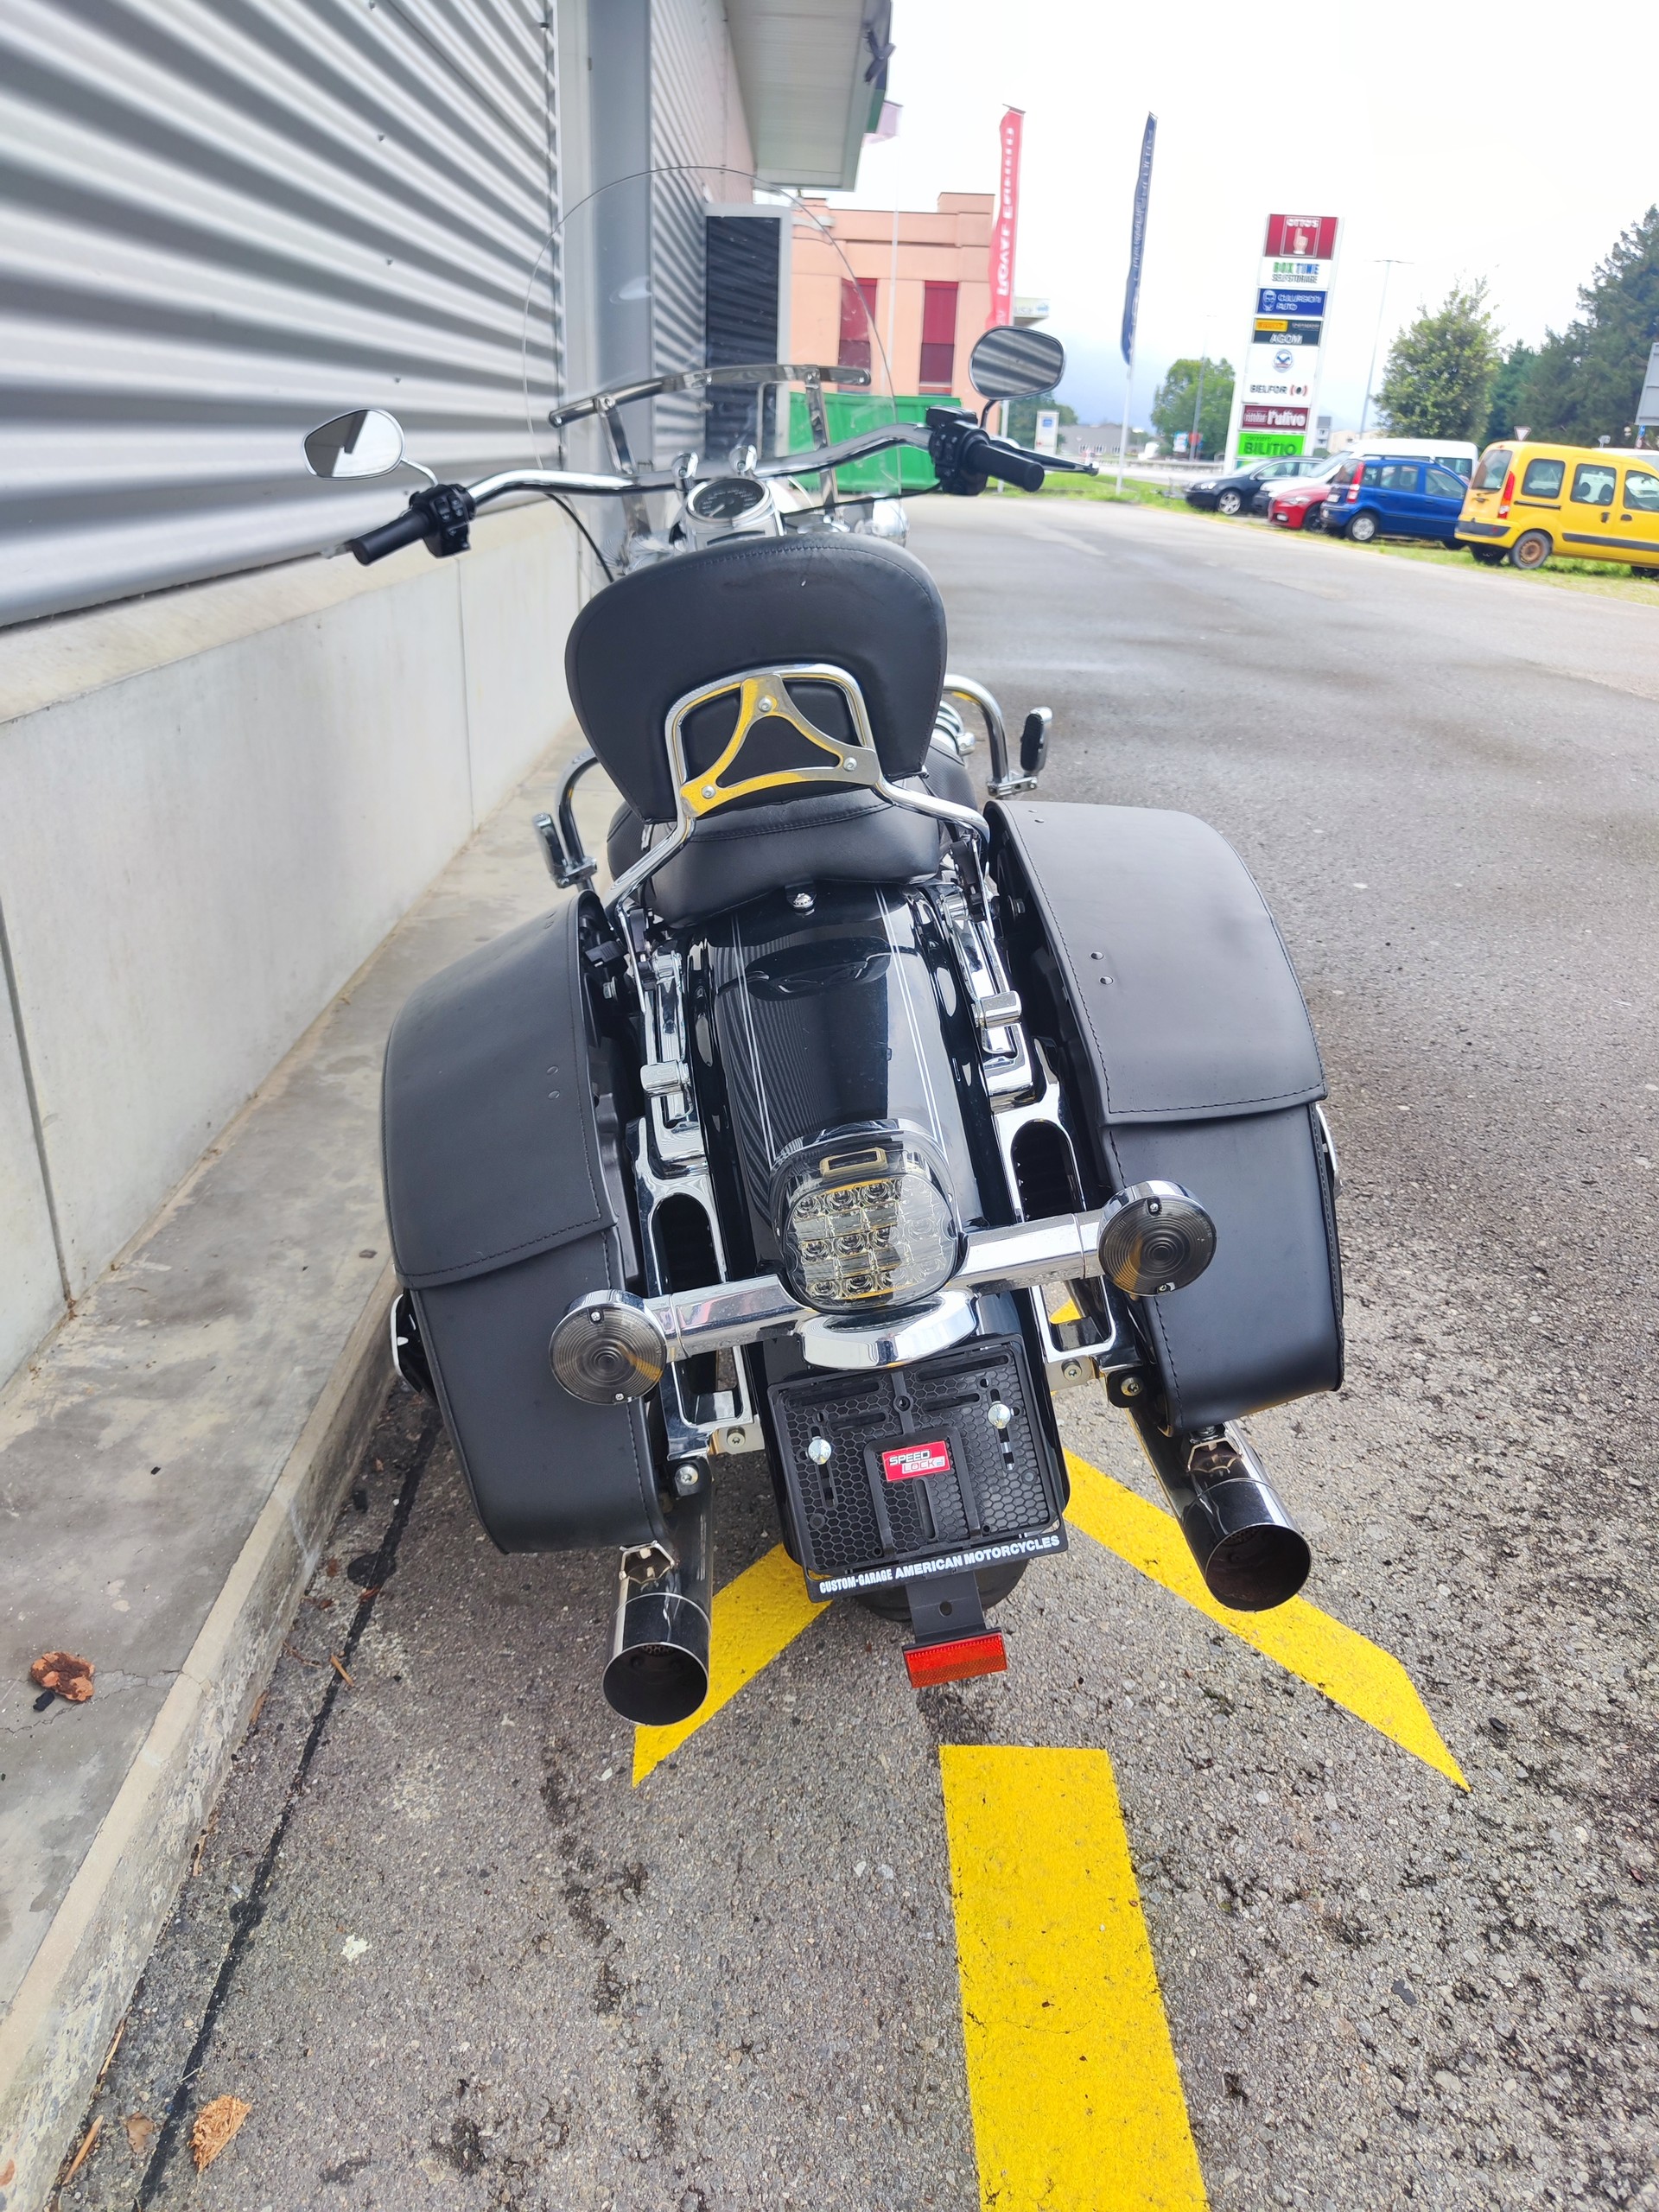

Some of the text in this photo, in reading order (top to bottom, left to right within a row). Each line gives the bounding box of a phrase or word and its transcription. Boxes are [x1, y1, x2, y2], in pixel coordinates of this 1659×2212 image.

[889, 1450, 931, 1466] SPEED
[903, 1459, 935, 1472] LOCK
[895, 1555, 963, 1580] AMERICAN
[964, 1535, 1060, 1566] MOTORCYCLES
